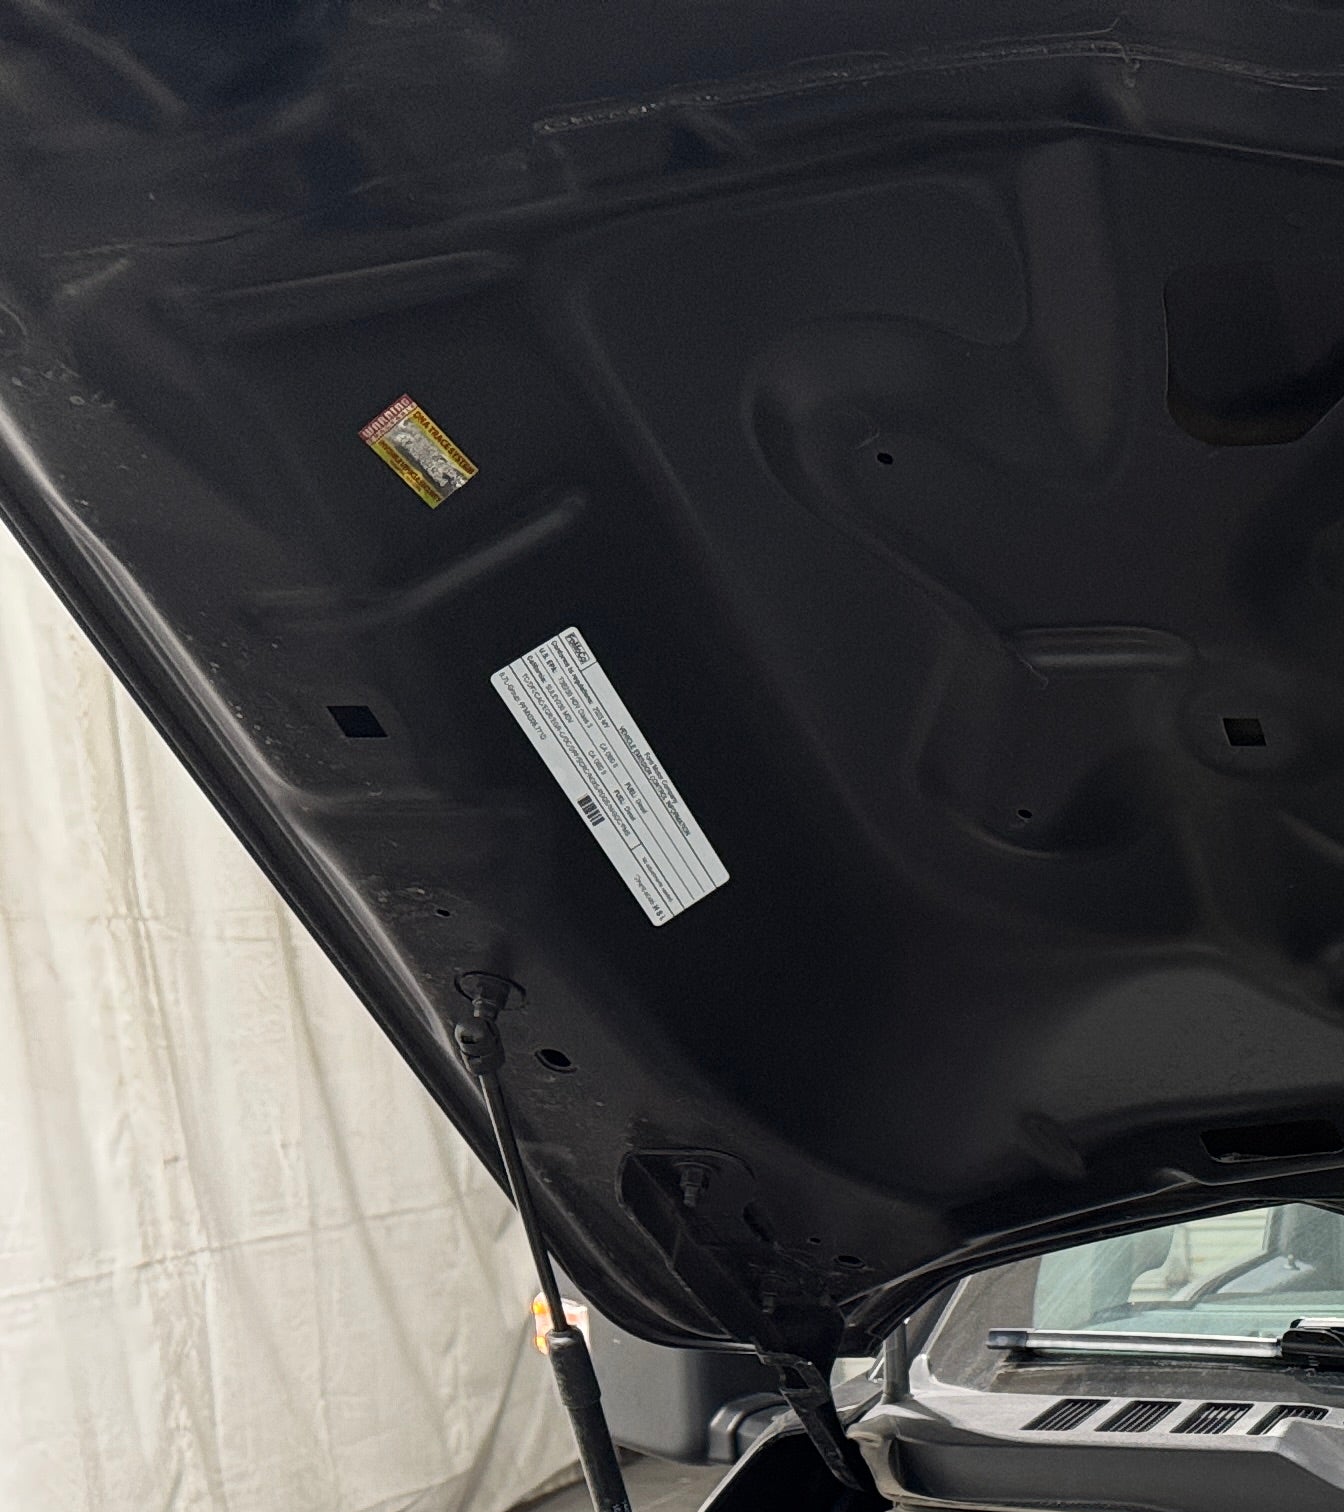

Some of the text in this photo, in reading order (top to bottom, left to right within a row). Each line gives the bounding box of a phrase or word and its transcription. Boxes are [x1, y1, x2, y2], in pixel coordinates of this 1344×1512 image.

[617, 725, 636, 749] VEHICLE
[648, 774, 668, 800] CONTROL
[665, 800, 691, 837] INFORMATION
